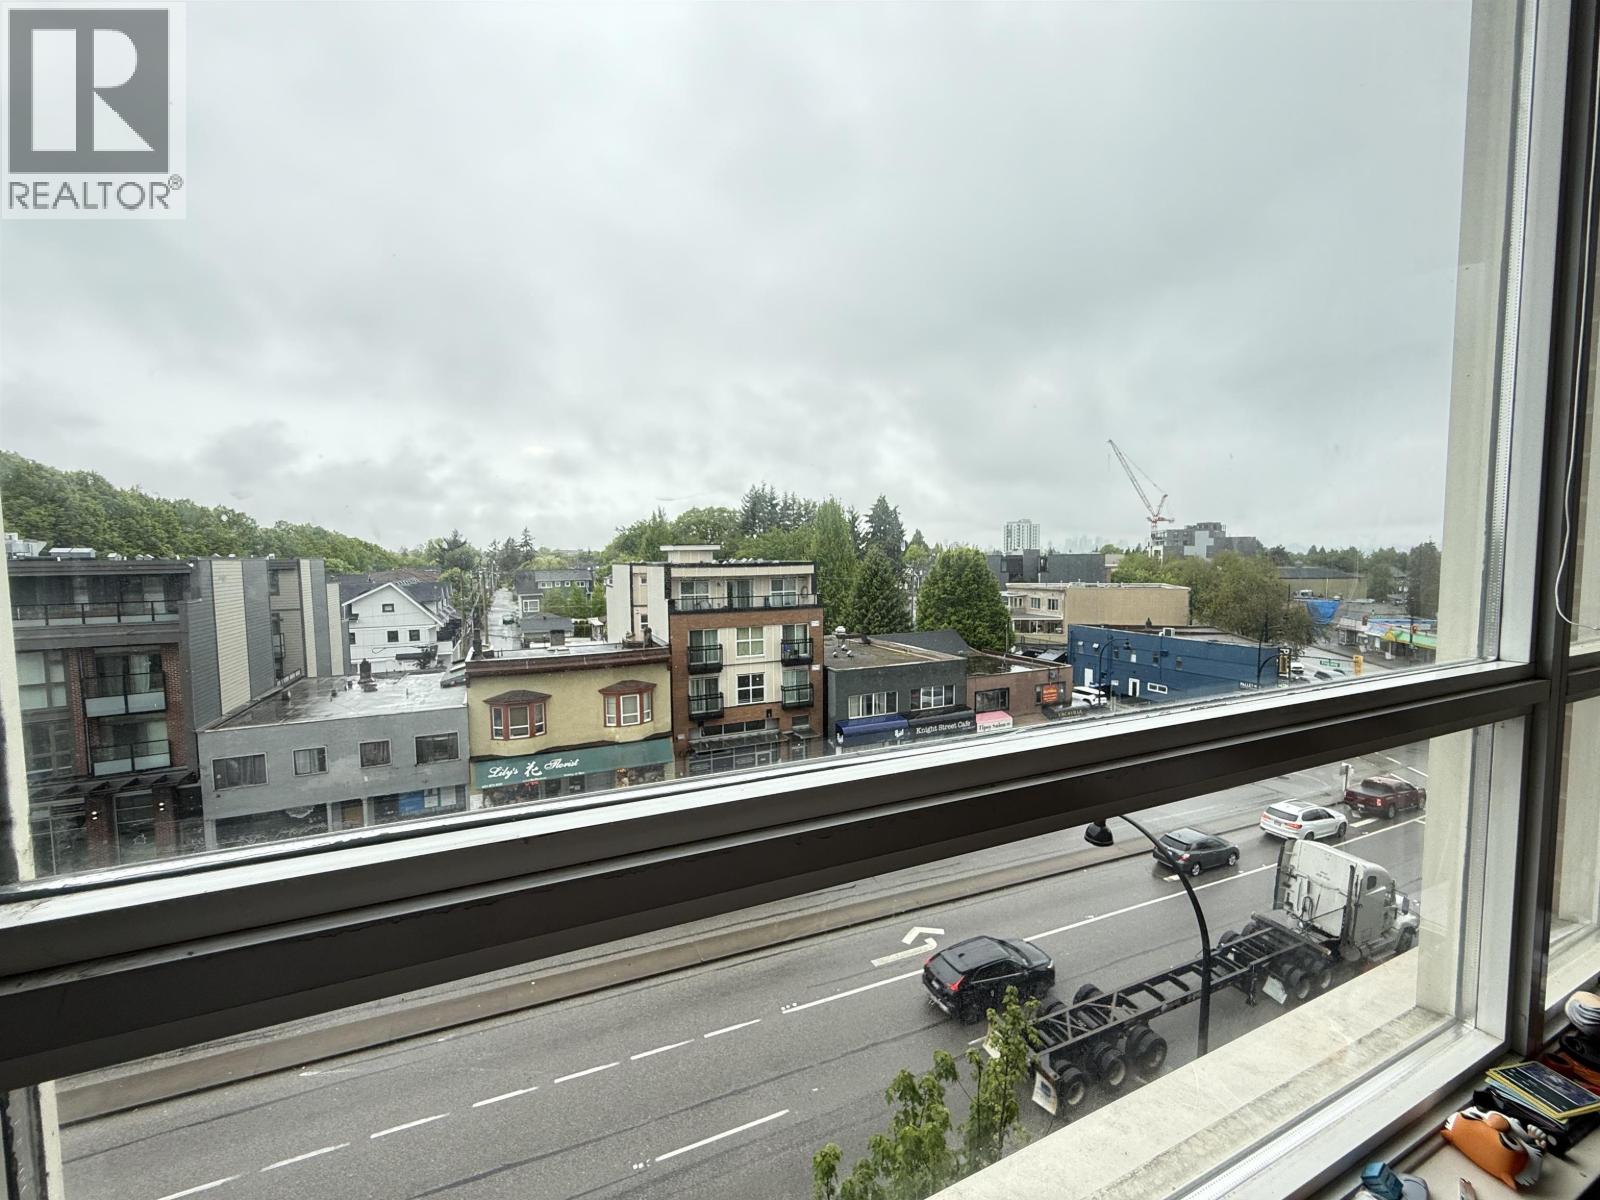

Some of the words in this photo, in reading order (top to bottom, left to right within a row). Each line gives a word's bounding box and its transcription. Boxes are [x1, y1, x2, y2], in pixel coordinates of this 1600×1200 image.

[916, 725, 937, 735] Knight
[938, 723, 957, 732] Street
[488, 766, 518, 780] Lily's
[544, 758, 580, 770] Florist
